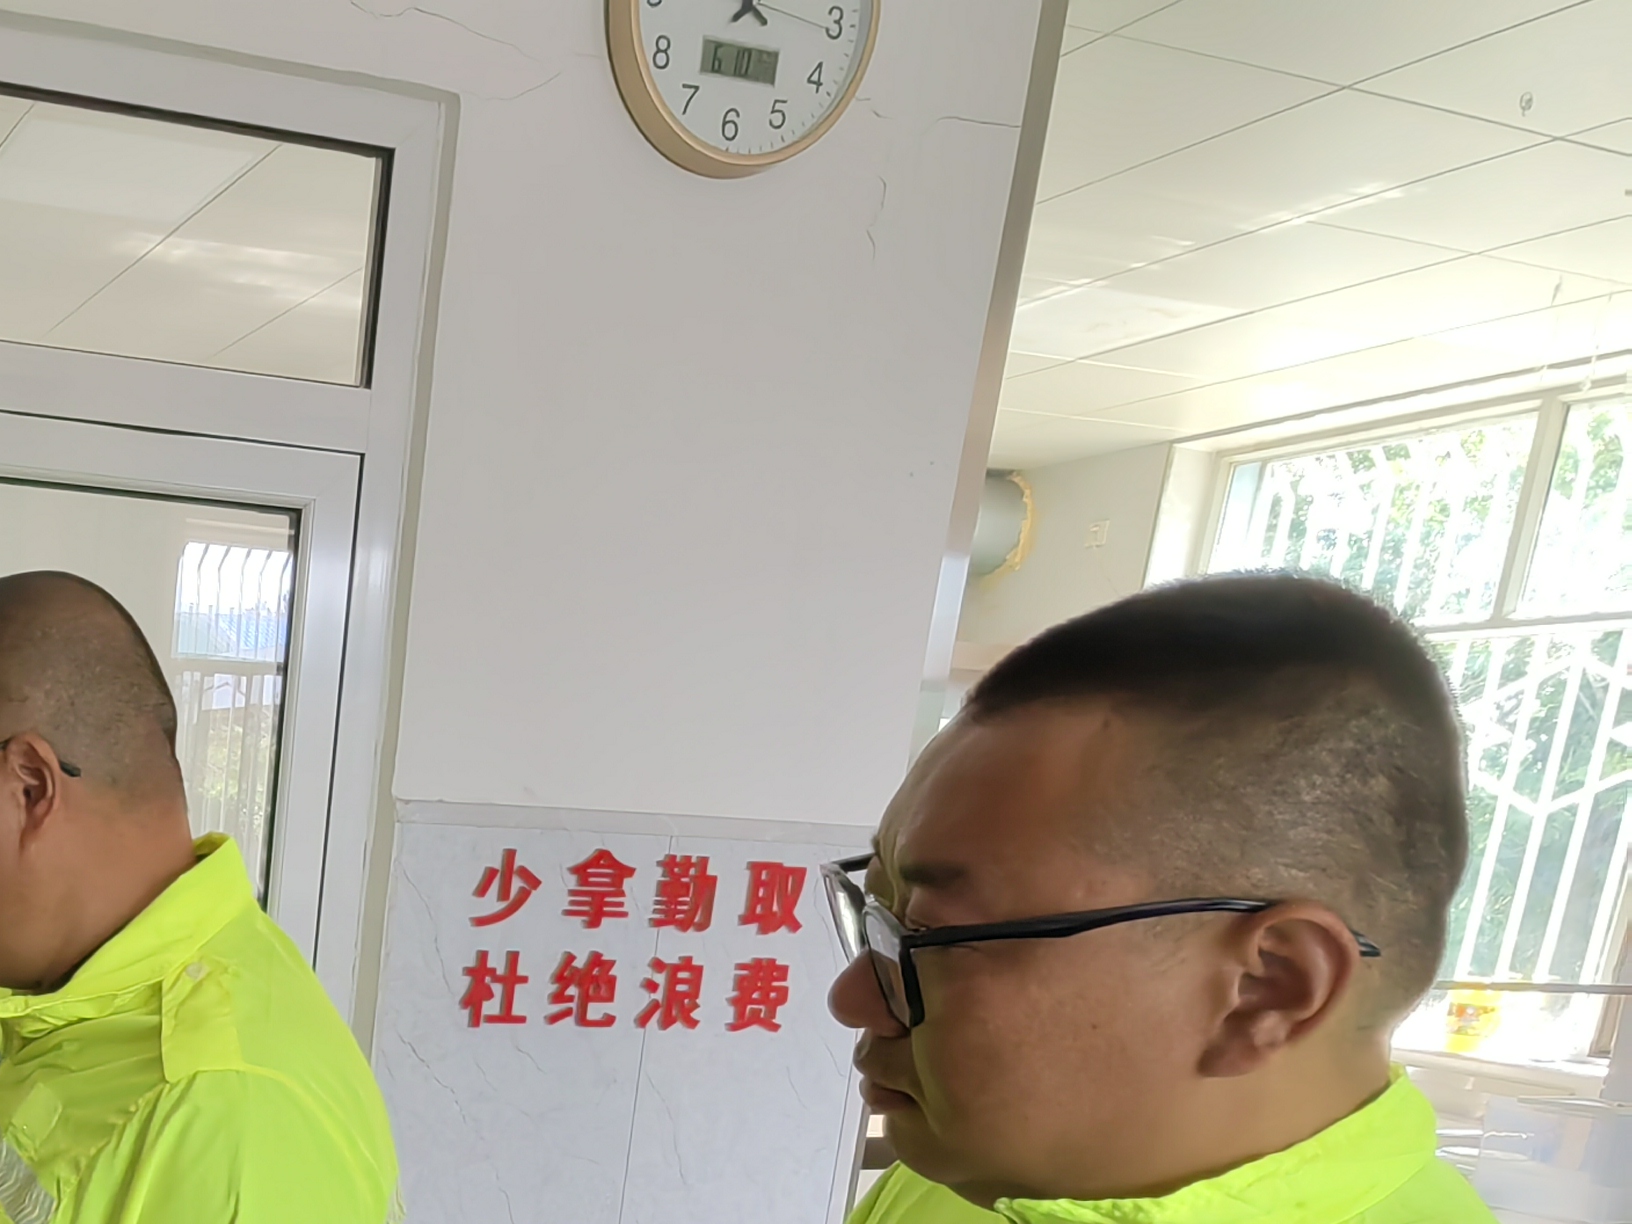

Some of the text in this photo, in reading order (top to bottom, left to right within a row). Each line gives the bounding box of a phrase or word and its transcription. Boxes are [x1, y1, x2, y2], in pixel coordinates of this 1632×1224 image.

[825, 5, 844, 40] 3
[652, 34, 671, 70] 8
[806, 61, 825, 94] 4
[681, 83, 700, 115] 7
[768, 99, 788, 129] 5
[721, 107, 741, 141] 6
[468, 847, 808, 936] 少拿勤取
[459, 949, 790, 1033] 杜绝浪费
